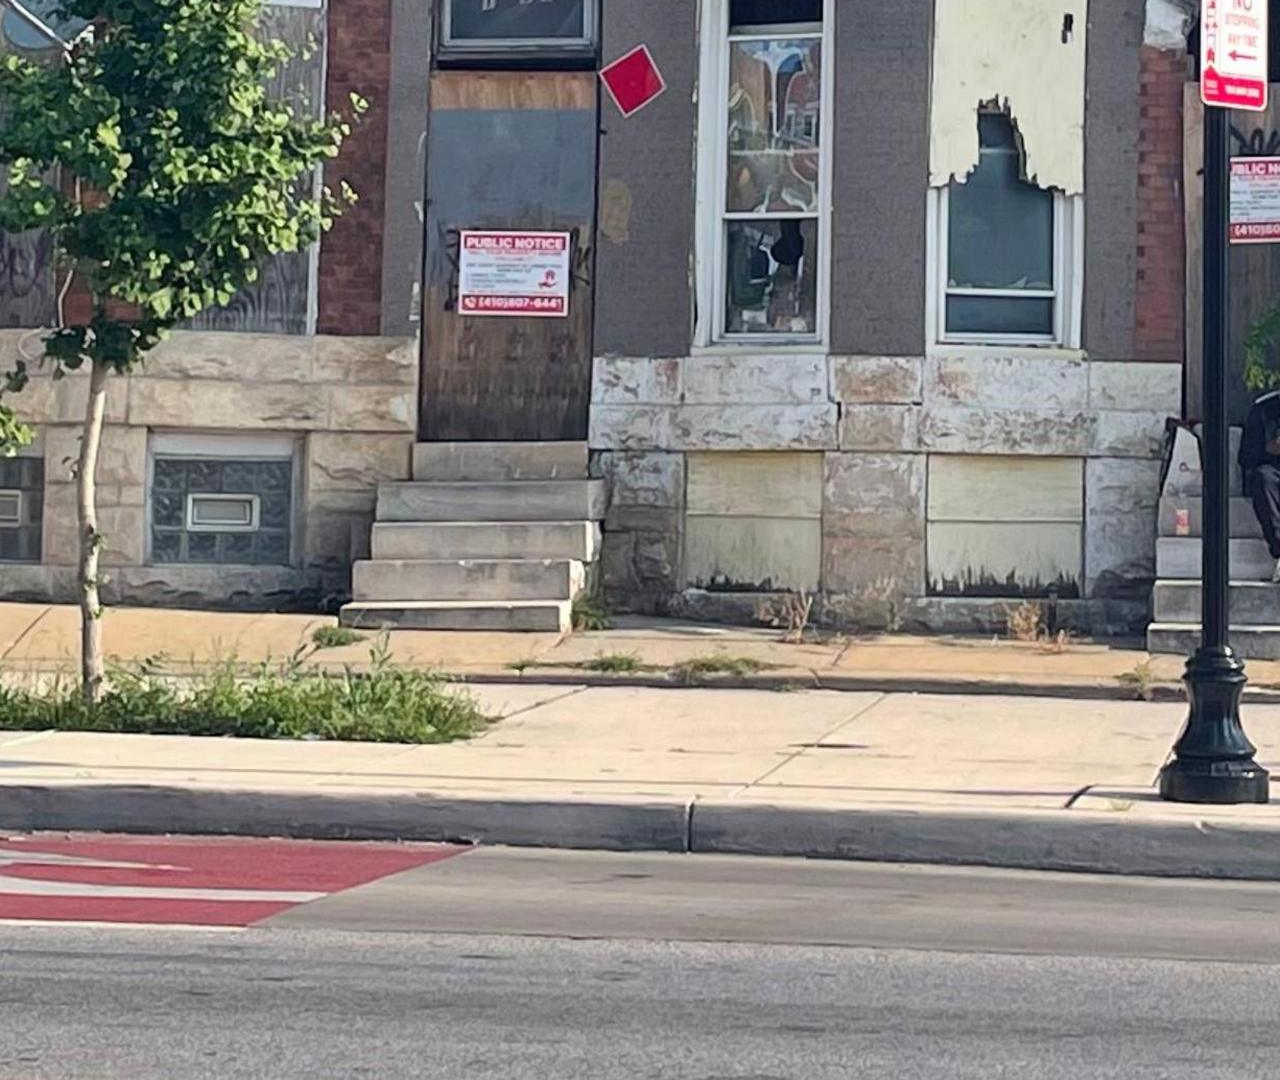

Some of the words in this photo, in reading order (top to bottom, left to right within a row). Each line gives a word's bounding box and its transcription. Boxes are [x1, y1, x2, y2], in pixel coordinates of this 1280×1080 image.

[1225, 12, 1260, 31] STOPPING
[466, 236, 513, 249] PUBLIC
[515, 237, 564, 250] NOTICE
